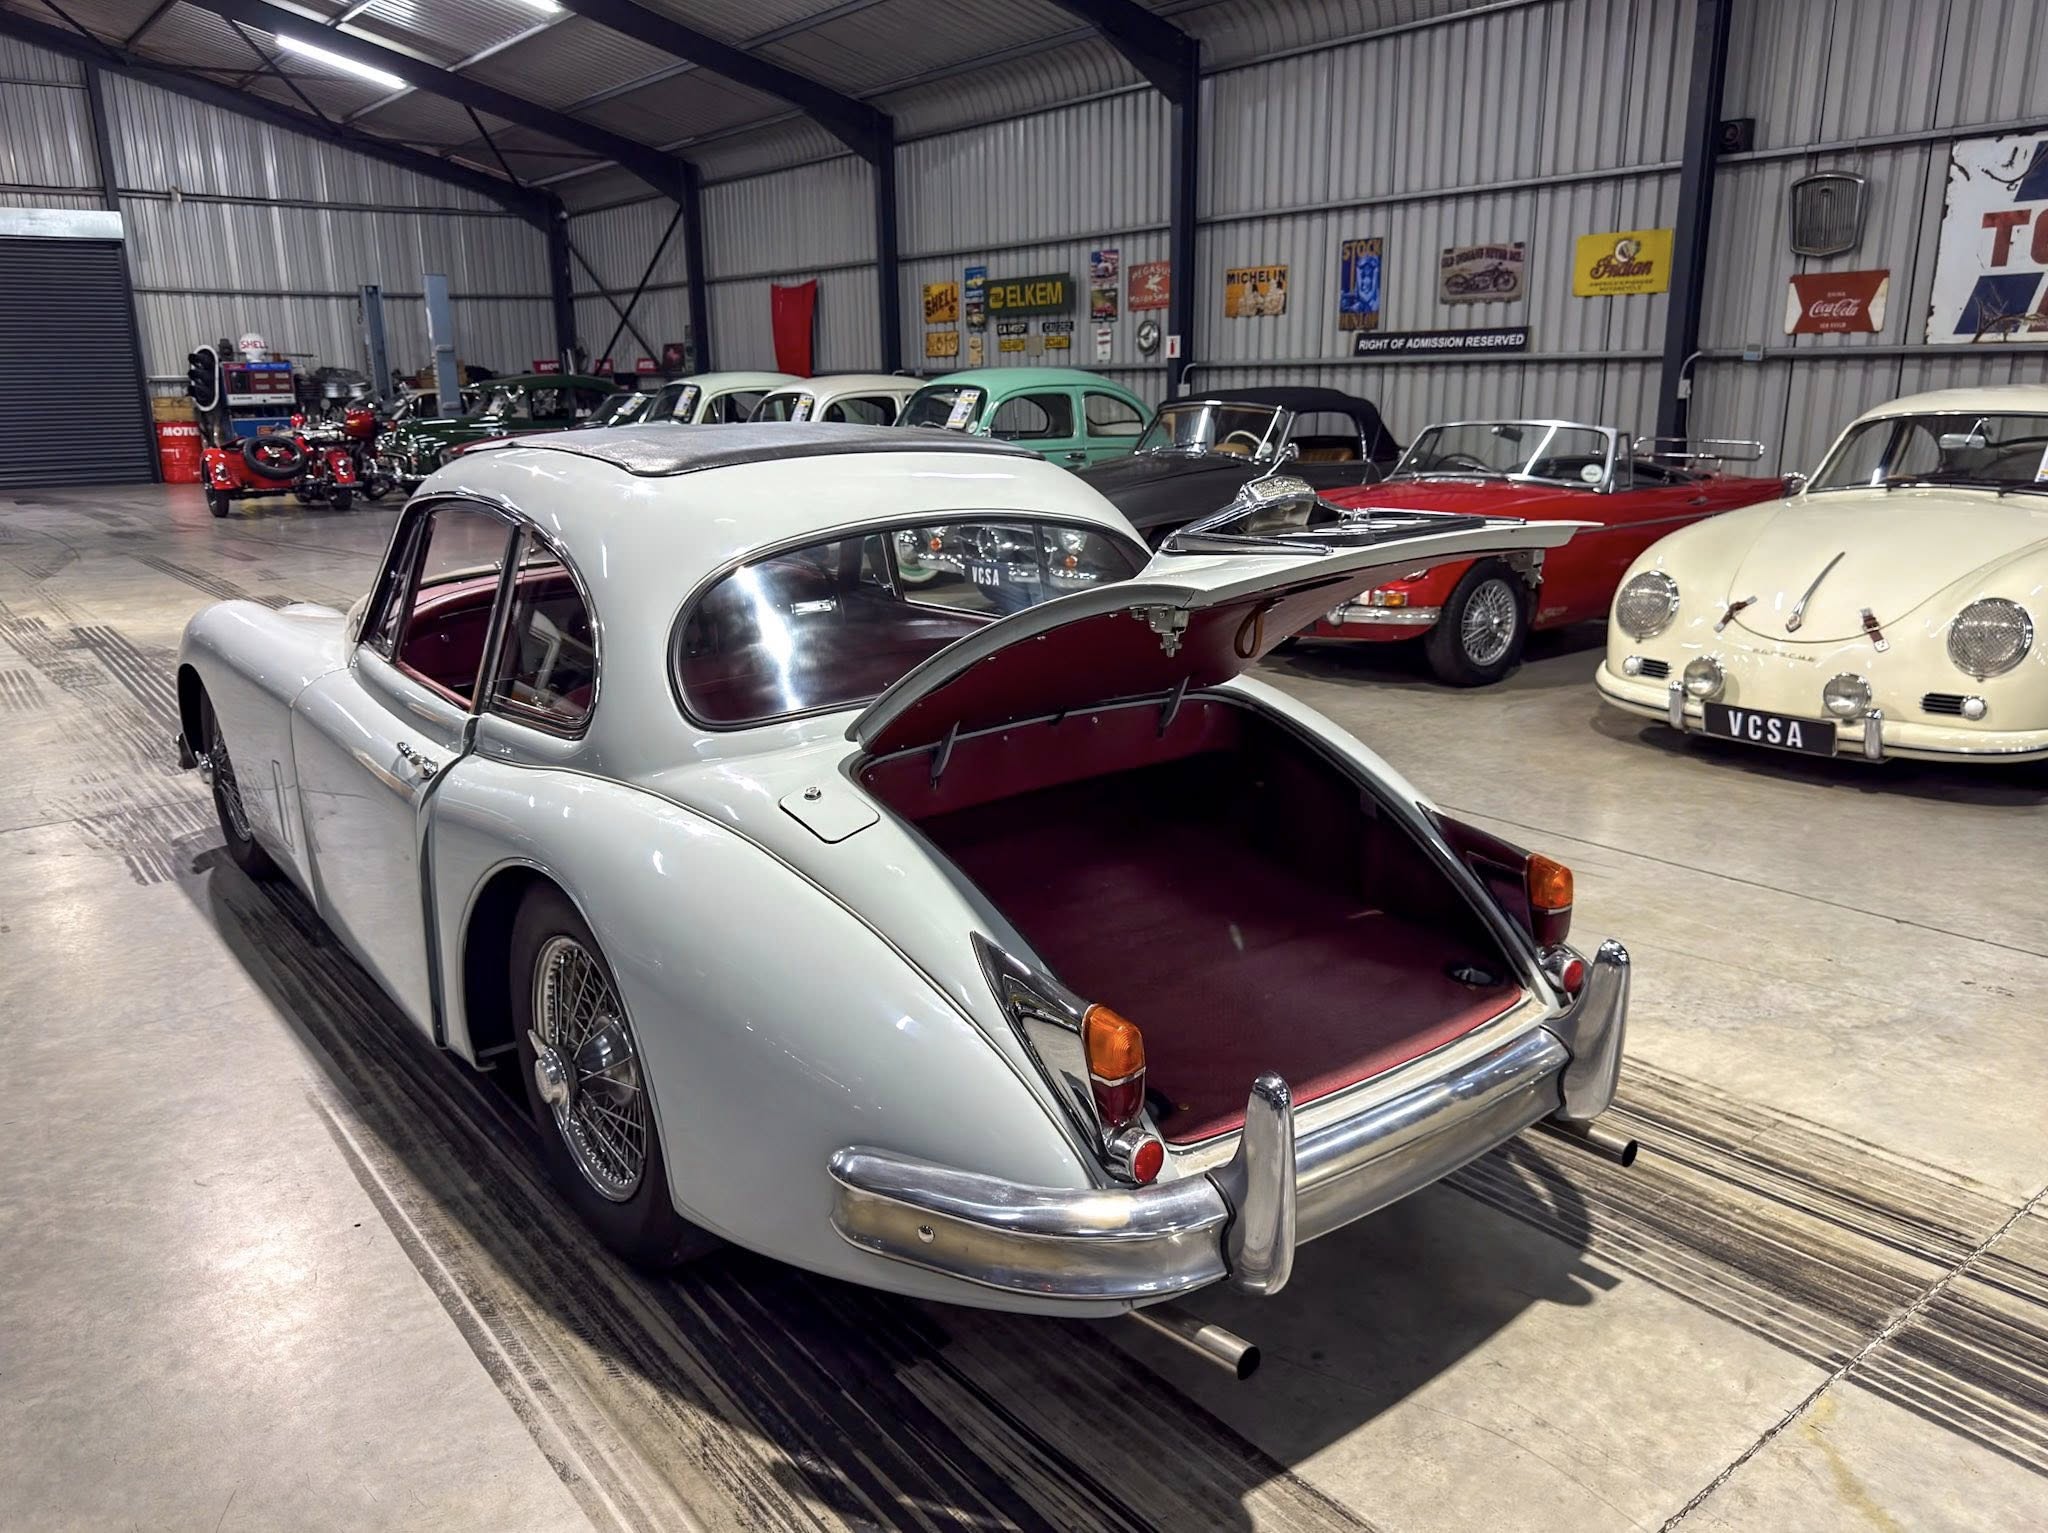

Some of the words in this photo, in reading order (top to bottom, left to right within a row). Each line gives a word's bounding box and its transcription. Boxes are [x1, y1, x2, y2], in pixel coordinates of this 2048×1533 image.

[1131, 264, 1170, 281] PEGASU
[1590, 254, 1653, 279] Indian
[1227, 269, 1286, 285] MICHELIN
[925, 285, 957, 318] SHELL
[1006, 281, 1063, 308] ELKEM
[240, 340, 268, 349] SHELL
[1358, 339, 1388, 350] RIGHT
[1390, 338, 1404, 349] OF
[1406, 336, 1464, 349] ADMISSION
[1465, 333, 1525, 347] RESERVED
[162, 426, 200, 437] MOTU
[972, 566, 999, 586] VCSA
[1728, 710, 1803, 749] VCSA
